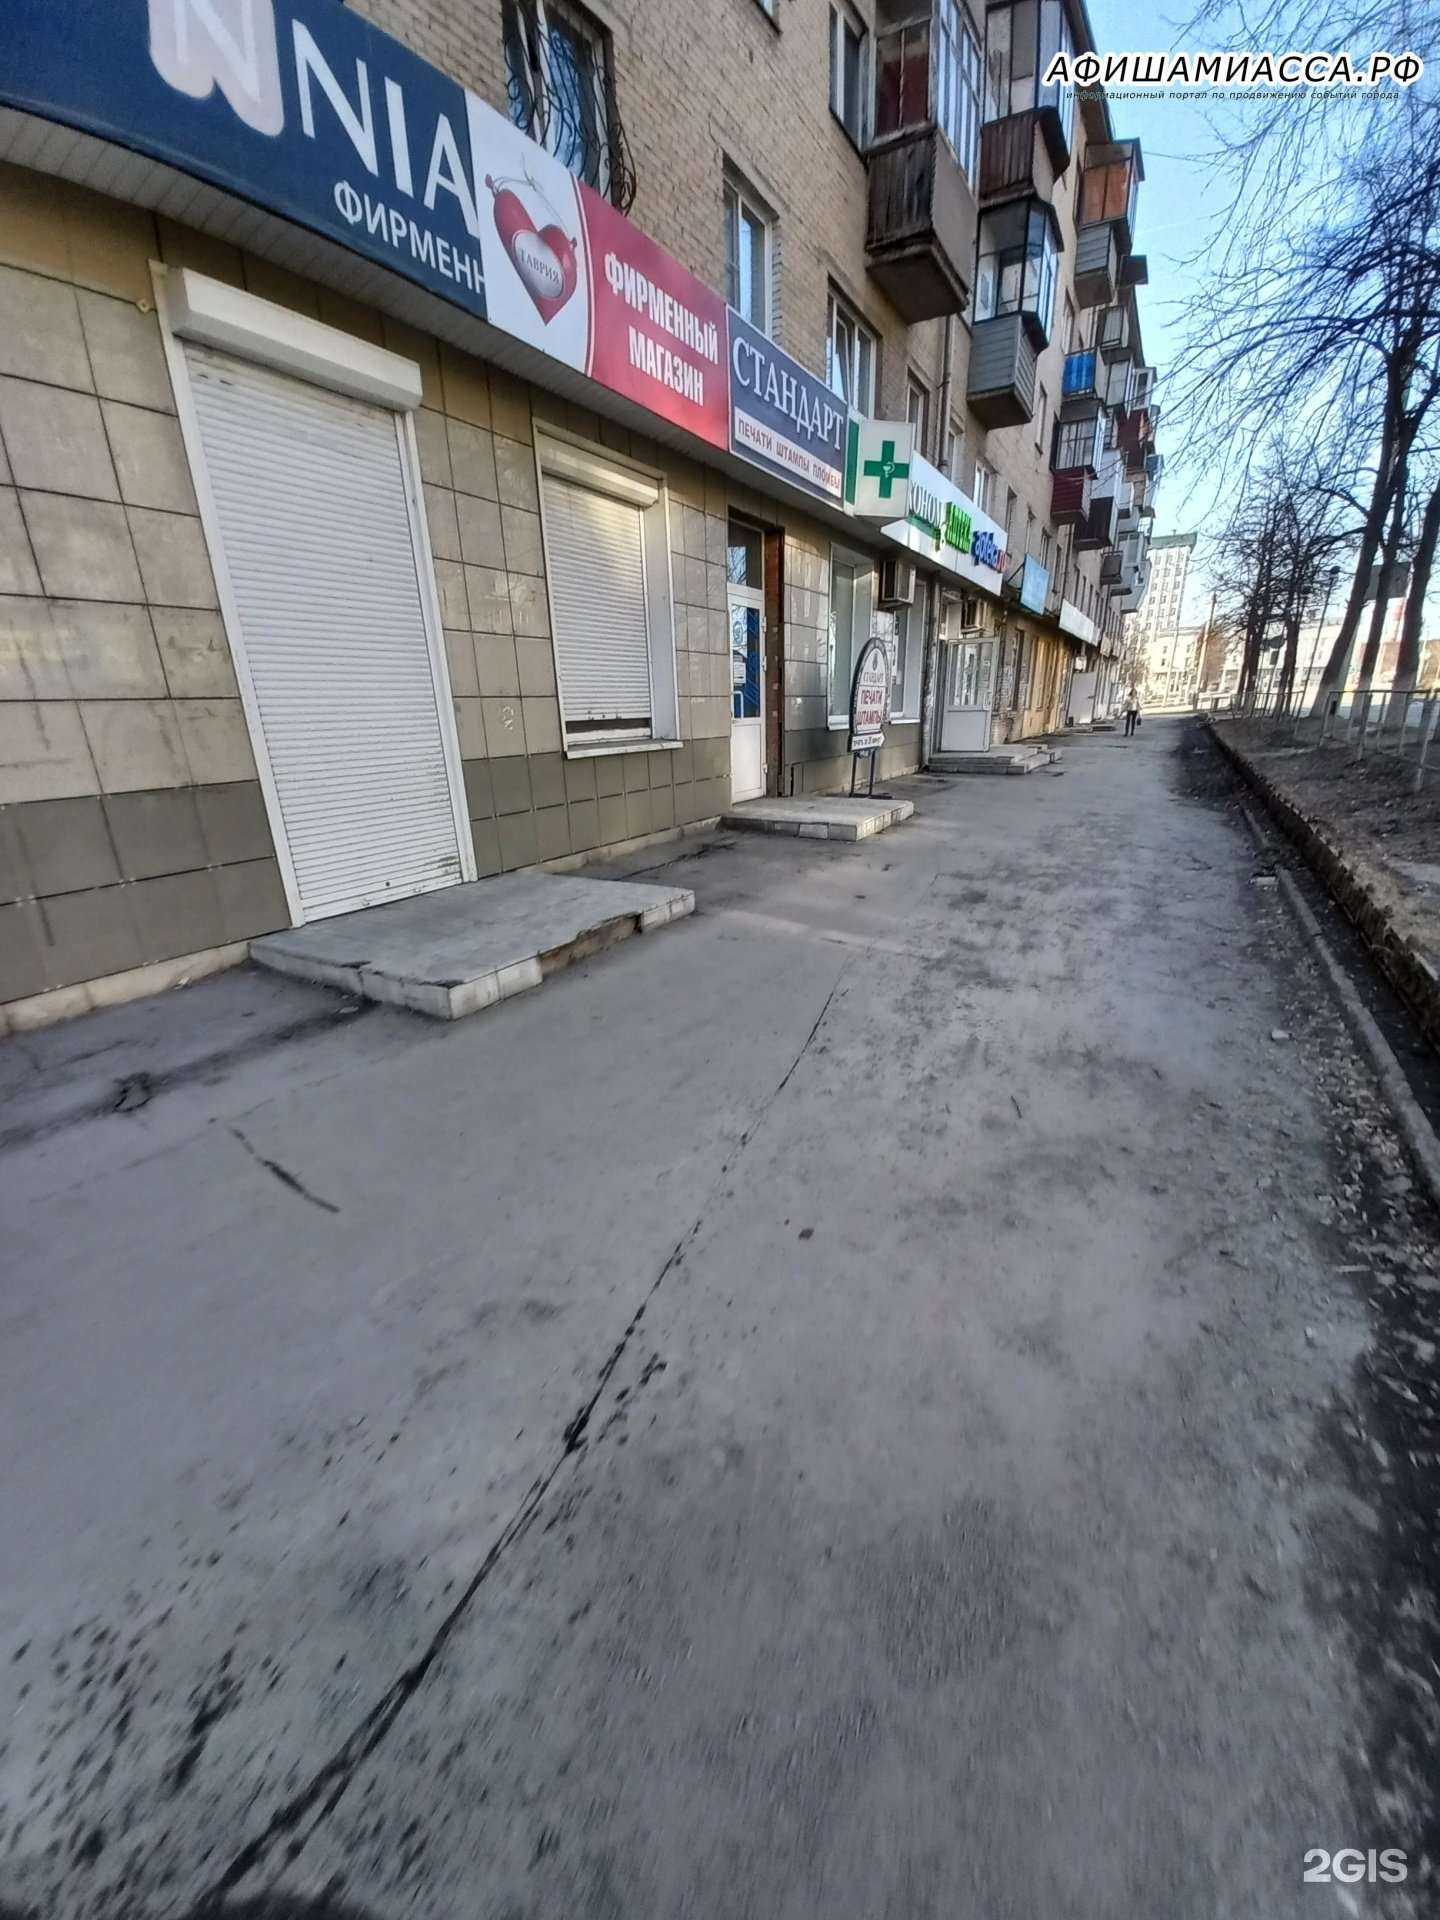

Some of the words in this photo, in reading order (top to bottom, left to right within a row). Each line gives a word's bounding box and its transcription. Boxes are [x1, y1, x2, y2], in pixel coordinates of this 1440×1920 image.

[604, 251, 719, 365] ФИРМЕННЫЙ
[628, 326, 705, 406] МАГАЗИН
[732, 337, 844, 451] СТАНДАРТ
[738, 419, 773, 453] ПЕЧАТИ
[776, 441, 810, 472] ШТАМПЫ
[860, 689, 883, 705] ПЕЧАТИ
